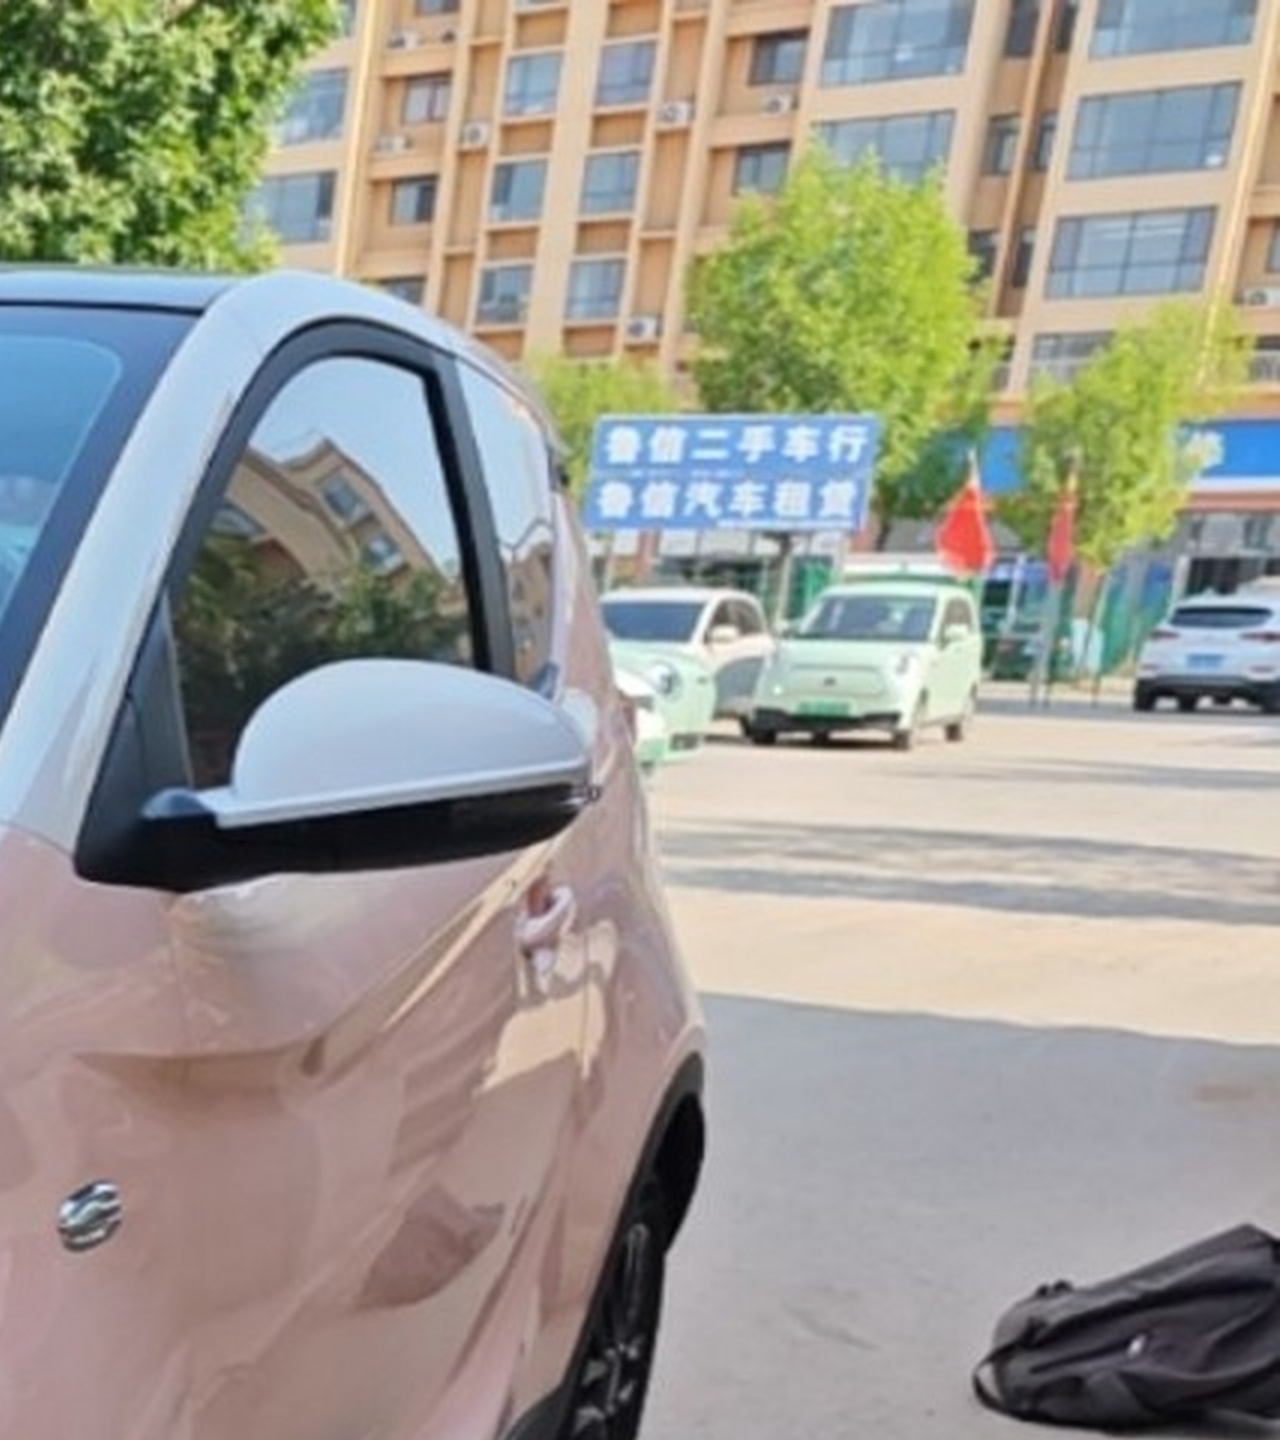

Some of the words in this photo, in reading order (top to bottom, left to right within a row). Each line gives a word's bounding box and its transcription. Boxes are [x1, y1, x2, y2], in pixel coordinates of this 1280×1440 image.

[605, 424, 869, 464] 鲁信二手车行
[597, 479, 858, 519] 鲁信汽车租赁
